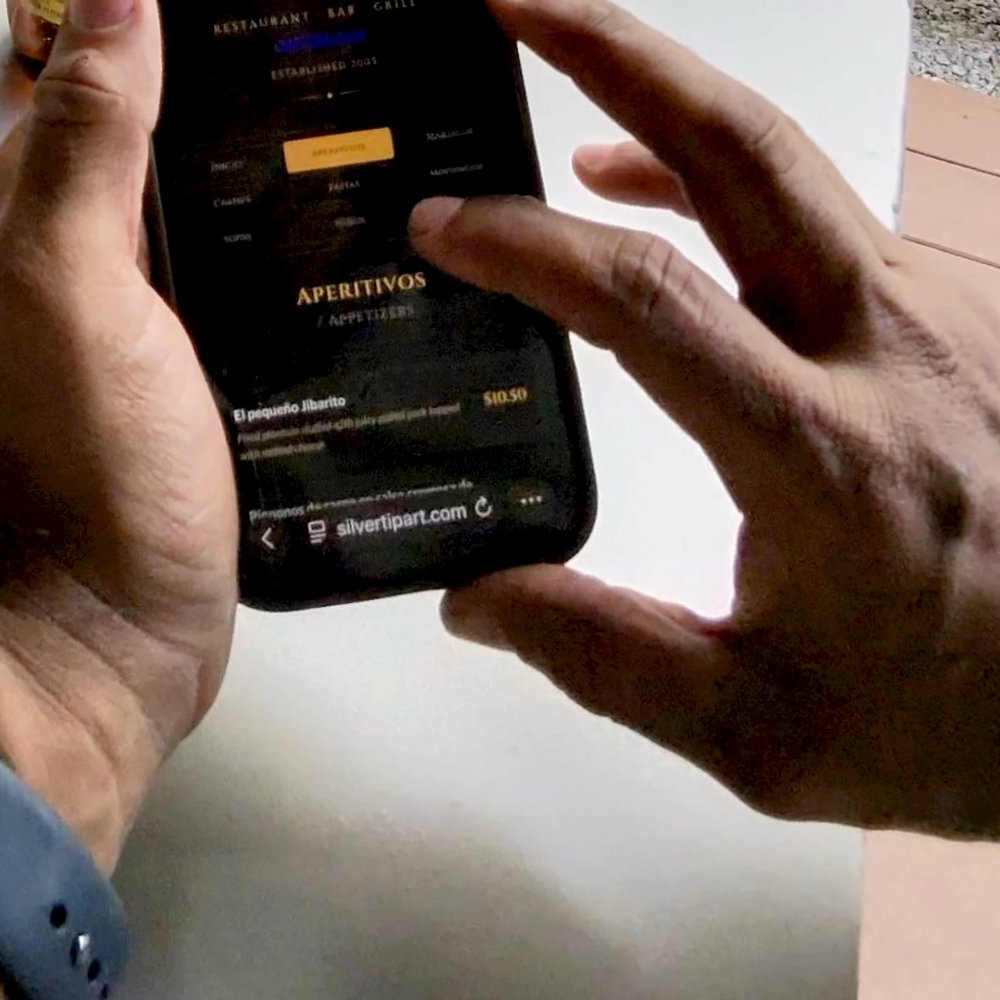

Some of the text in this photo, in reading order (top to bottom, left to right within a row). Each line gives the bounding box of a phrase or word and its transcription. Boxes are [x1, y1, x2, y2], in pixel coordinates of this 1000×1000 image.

[213, 11, 309, 35] RESTAURANT
[327, 4, 355, 19] BAR
[271, 60, 346, 80] ESTABLISHED
[296, 272, 427, 306] APERITIVOS
[483, 387, 528, 407] $10.50
[233, 408, 246, 422] El
[247, 402, 299, 422] pequeño
[336, 505, 468, 537] silvertipart.com
